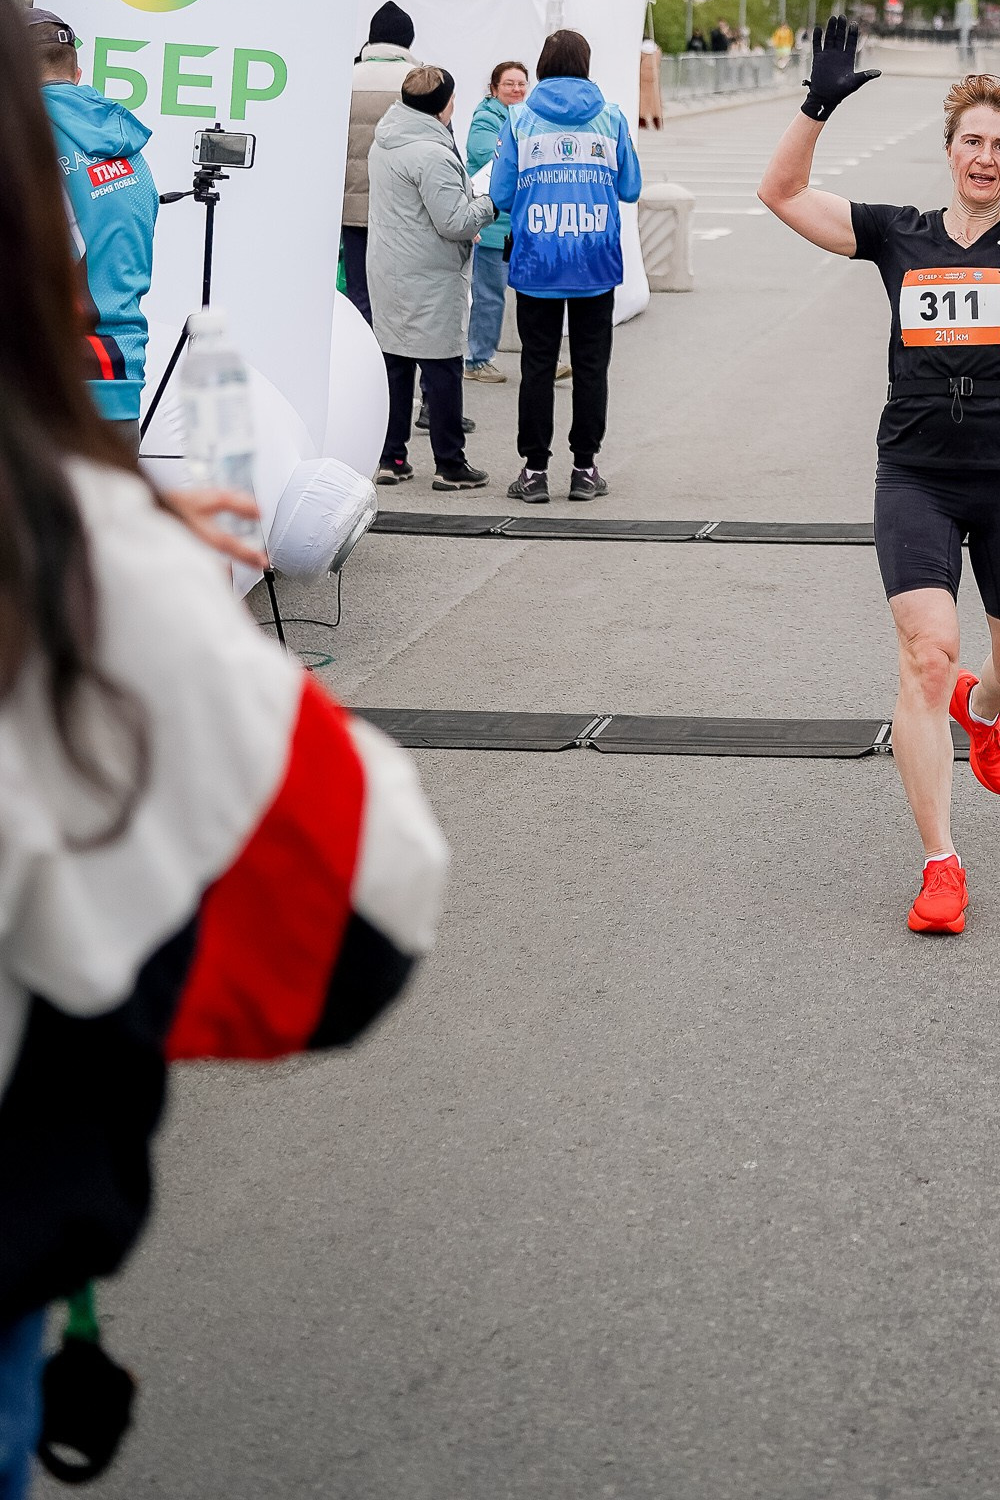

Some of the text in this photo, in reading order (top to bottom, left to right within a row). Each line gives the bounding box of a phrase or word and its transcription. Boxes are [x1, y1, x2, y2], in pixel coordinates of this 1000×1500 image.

[74, 36, 288, 120] БЕР
[92, 159, 128, 182] TIME
[90, 185, 114, 200] ВРЕМЯ
[527, 202, 609, 238] СУДЬЯ
[919, 290, 979, 321] 311
[935, 329, 955, 343] 21,1
